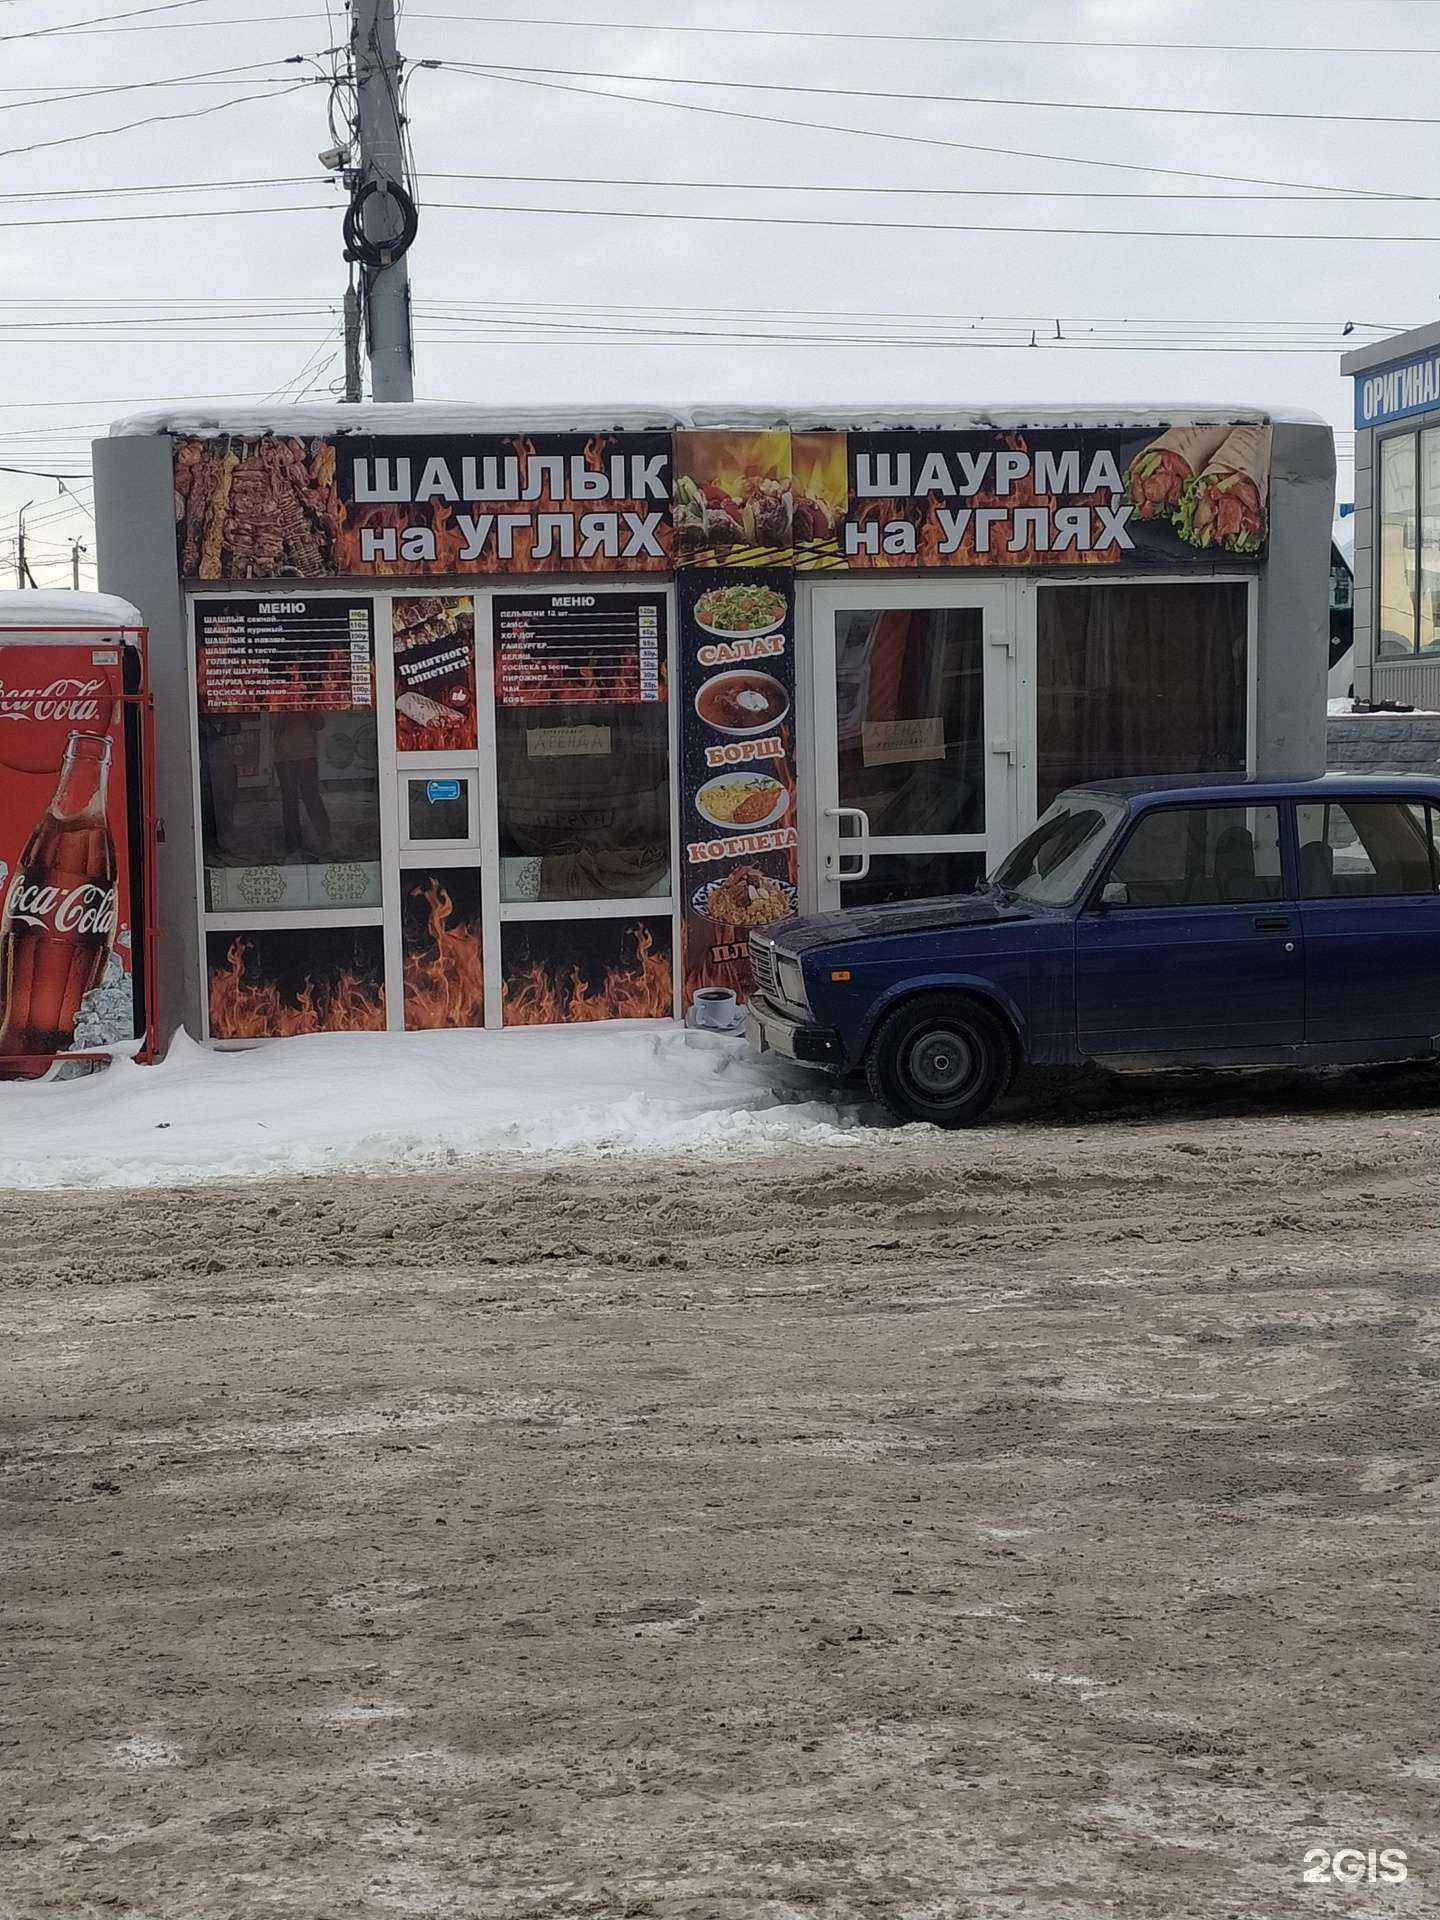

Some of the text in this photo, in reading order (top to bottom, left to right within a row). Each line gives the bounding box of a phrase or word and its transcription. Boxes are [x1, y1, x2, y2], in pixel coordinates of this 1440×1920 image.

[353, 455, 668, 502] ШАШЛЫК
[856, 450, 1124, 496] ШАУРМА
[360, 513, 665, 561] на УГЛЯХ
[845, 505, 1135, 555] на УГЛЯХ
[259, 602, 306, 614] МЕНЮ
[500, 610, 545, 618] ПЕЛЬМЕНИ
[551, 596, 596, 607] МЕНЮ
[204, 616, 245, 624] ШАШЛЫК
[204, 626, 246, 634] ШАШЛЫК
[205, 647, 246, 655] ШАШЛЫК
[399, 646, 469, 675] Приятного
[697, 634, 785, 666] САЛАТ
[407, 656, 471, 685] аппетита!
[705, 737, 785, 767] БОРЩ
[687, 827, 797, 863] КОТЛЕТА
[711, 942, 749, 962] ПЛ
